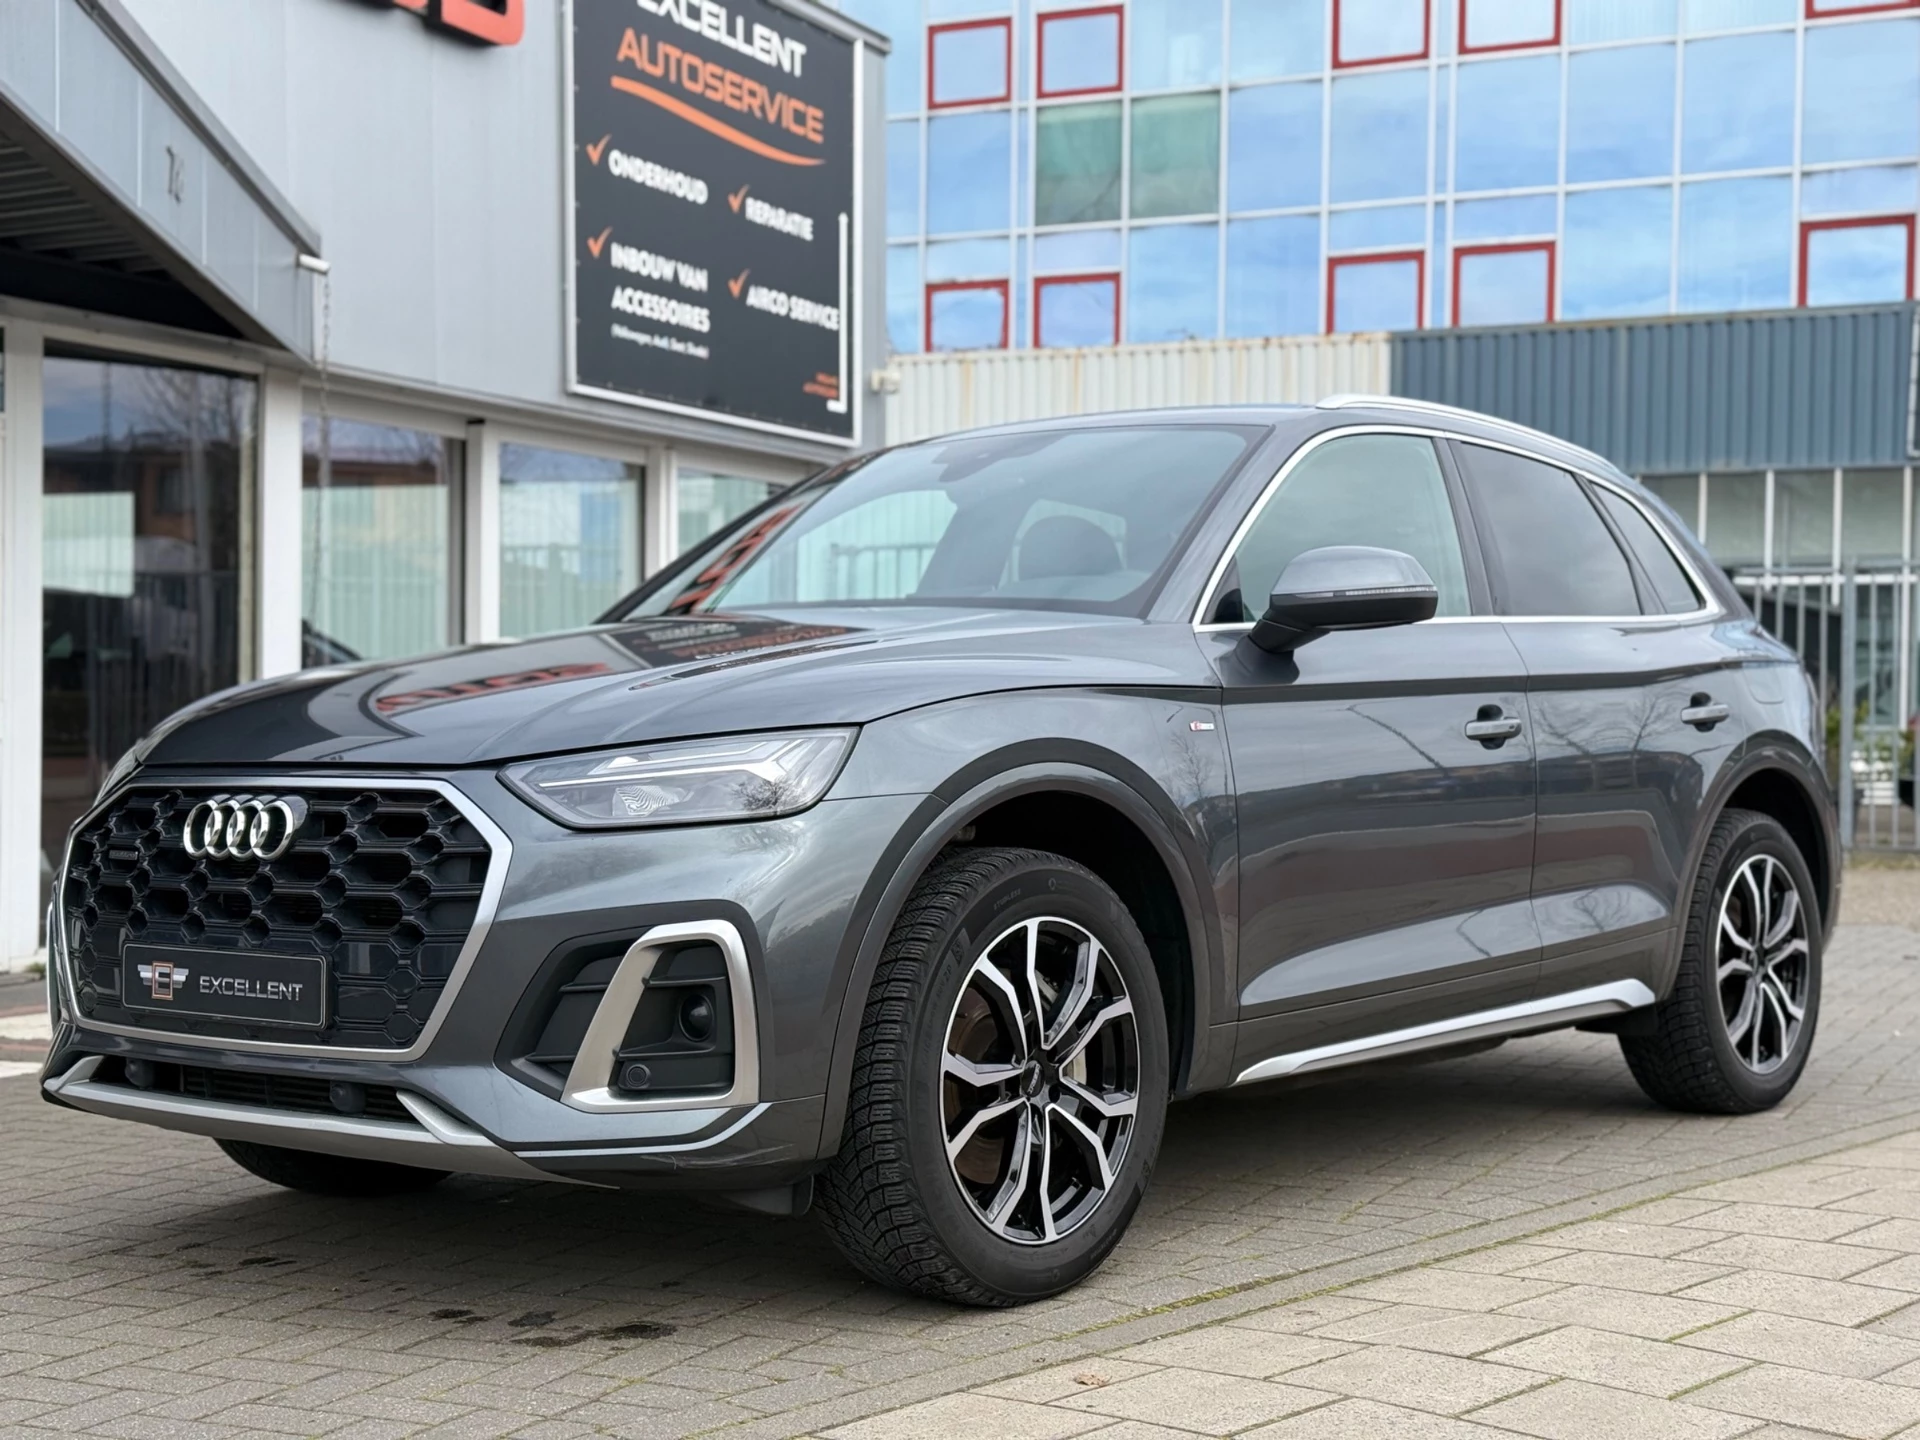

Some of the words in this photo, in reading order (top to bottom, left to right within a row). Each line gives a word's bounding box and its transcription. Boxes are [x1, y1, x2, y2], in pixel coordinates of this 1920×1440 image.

[636, 0, 807, 78] XCELLENT
[616, 26, 824, 144] AUTOSERVICE
[608, 149, 708, 204] ONDERHOUD
[745, 197, 813, 241] REPARATIE
[610, 242, 676, 282] INBOUW
[675, 261, 708, 292] VAN
[611, 285, 710, 333] ACCESSOIRES
[746, 285, 789, 316] AIRCO
[789, 295, 839, 331] SERVICE
[200, 975, 303, 1001] EXCELLENT
